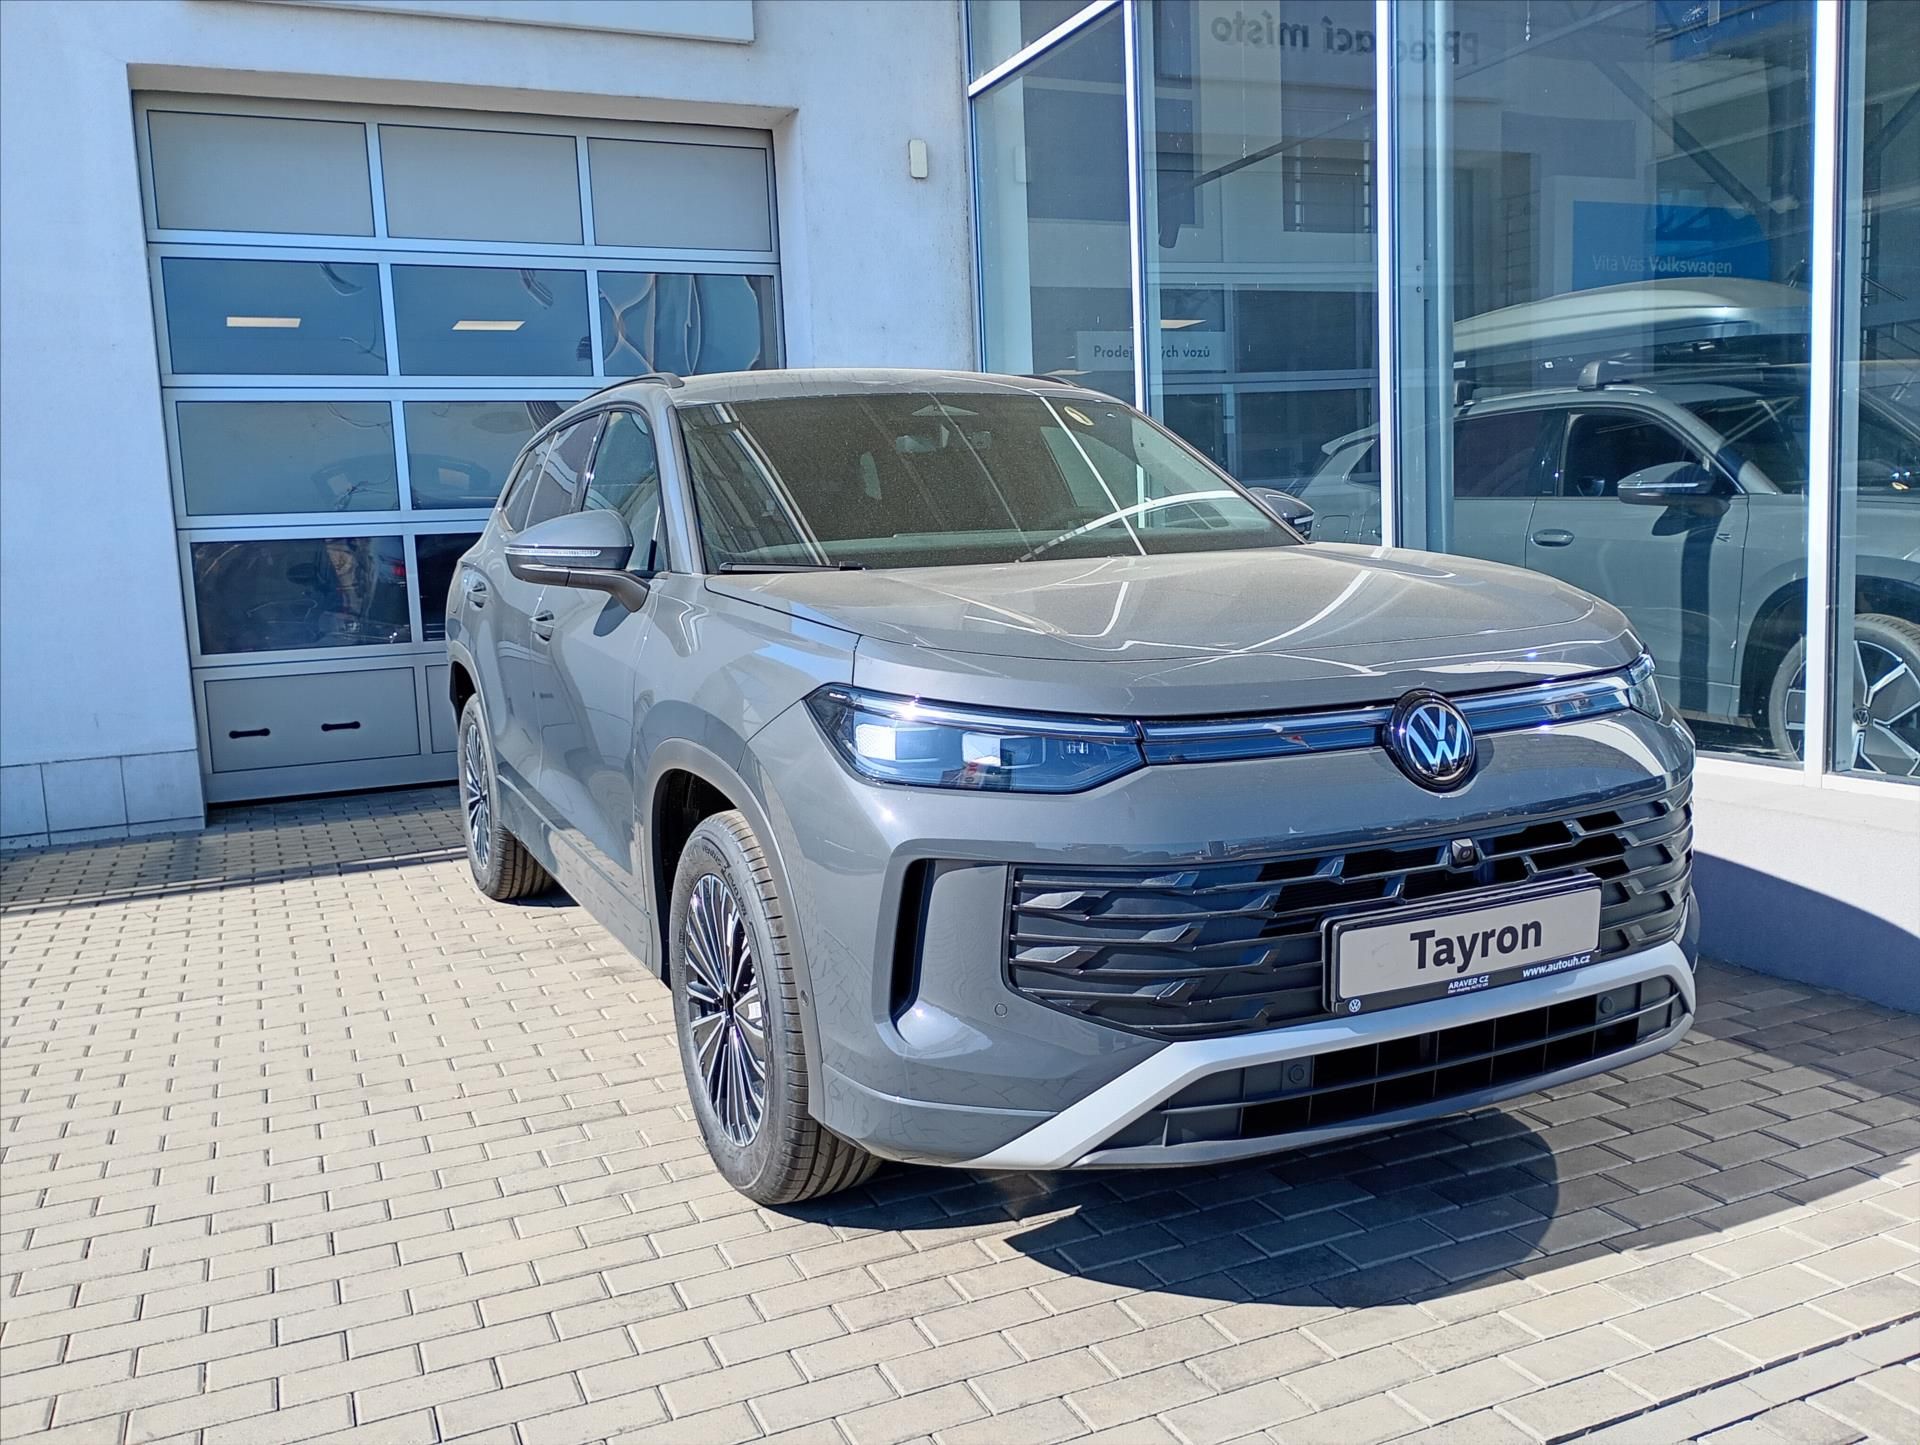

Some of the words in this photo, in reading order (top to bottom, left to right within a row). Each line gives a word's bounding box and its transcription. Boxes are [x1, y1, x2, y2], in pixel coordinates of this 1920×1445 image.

[1650, 255, 1733, 277] Volkswagen
[1410, 920, 1542, 973] Tayron
[1522, 954, 1591, 978] www.autouh.cz
[1448, 977, 1478, 990] ARAVER
[1479, 975, 1489, 985] CZ
